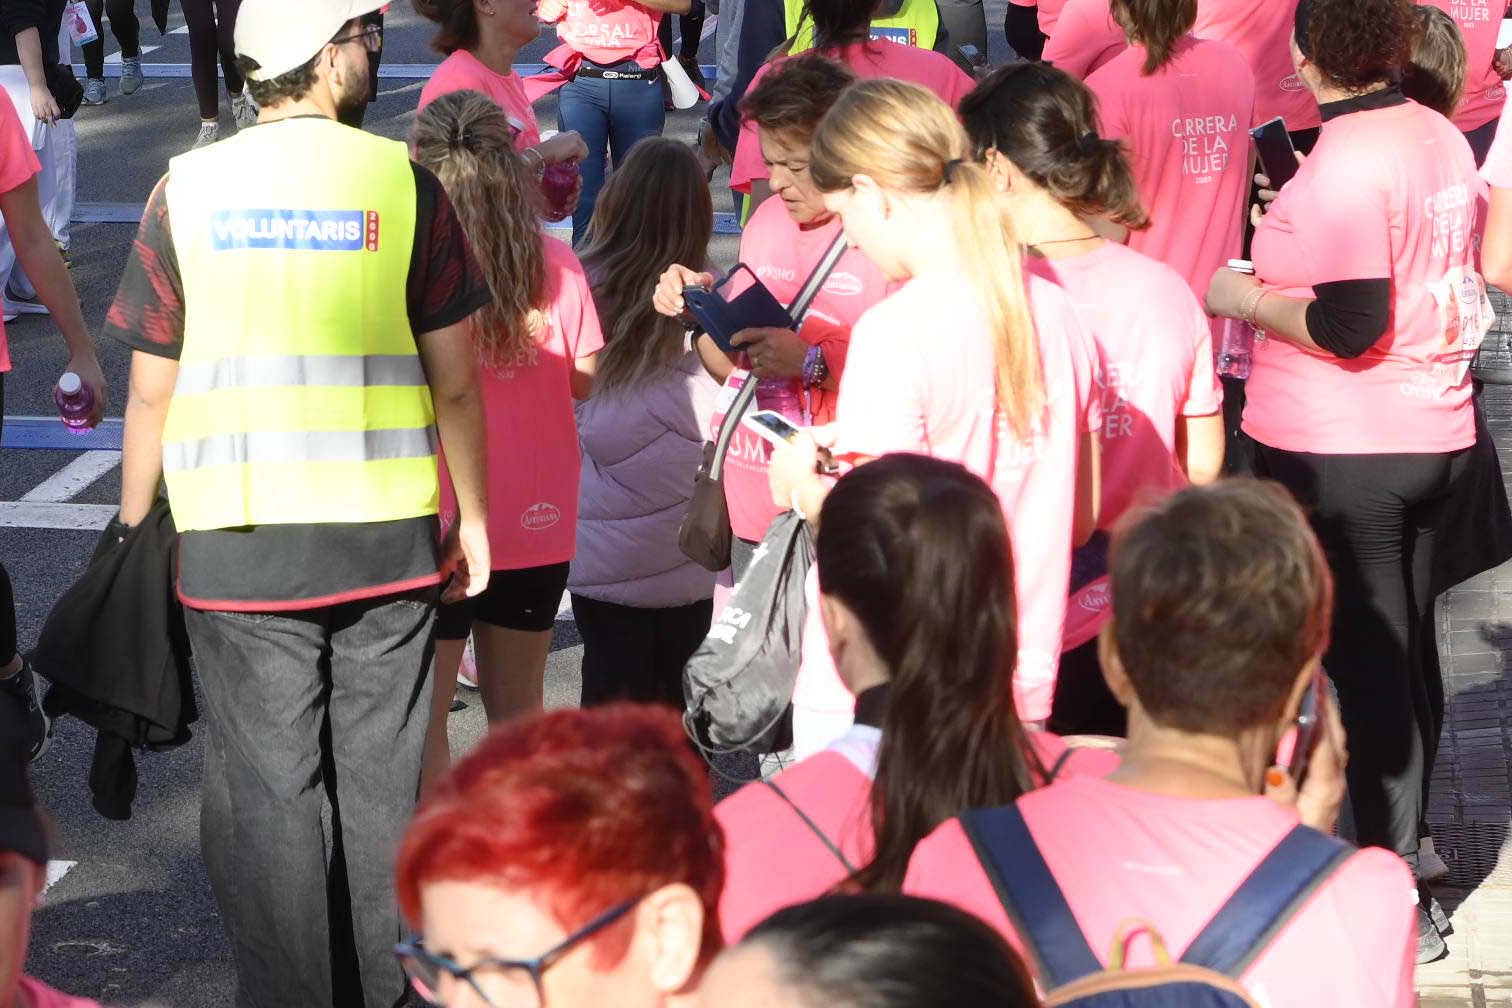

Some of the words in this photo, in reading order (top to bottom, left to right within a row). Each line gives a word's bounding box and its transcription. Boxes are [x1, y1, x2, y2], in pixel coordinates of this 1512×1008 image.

[1449, 4, 1490, 23] MUJER
[1205, 136, 1228, 153] LA
[215, 219, 361, 242] VOLUNTARIS
